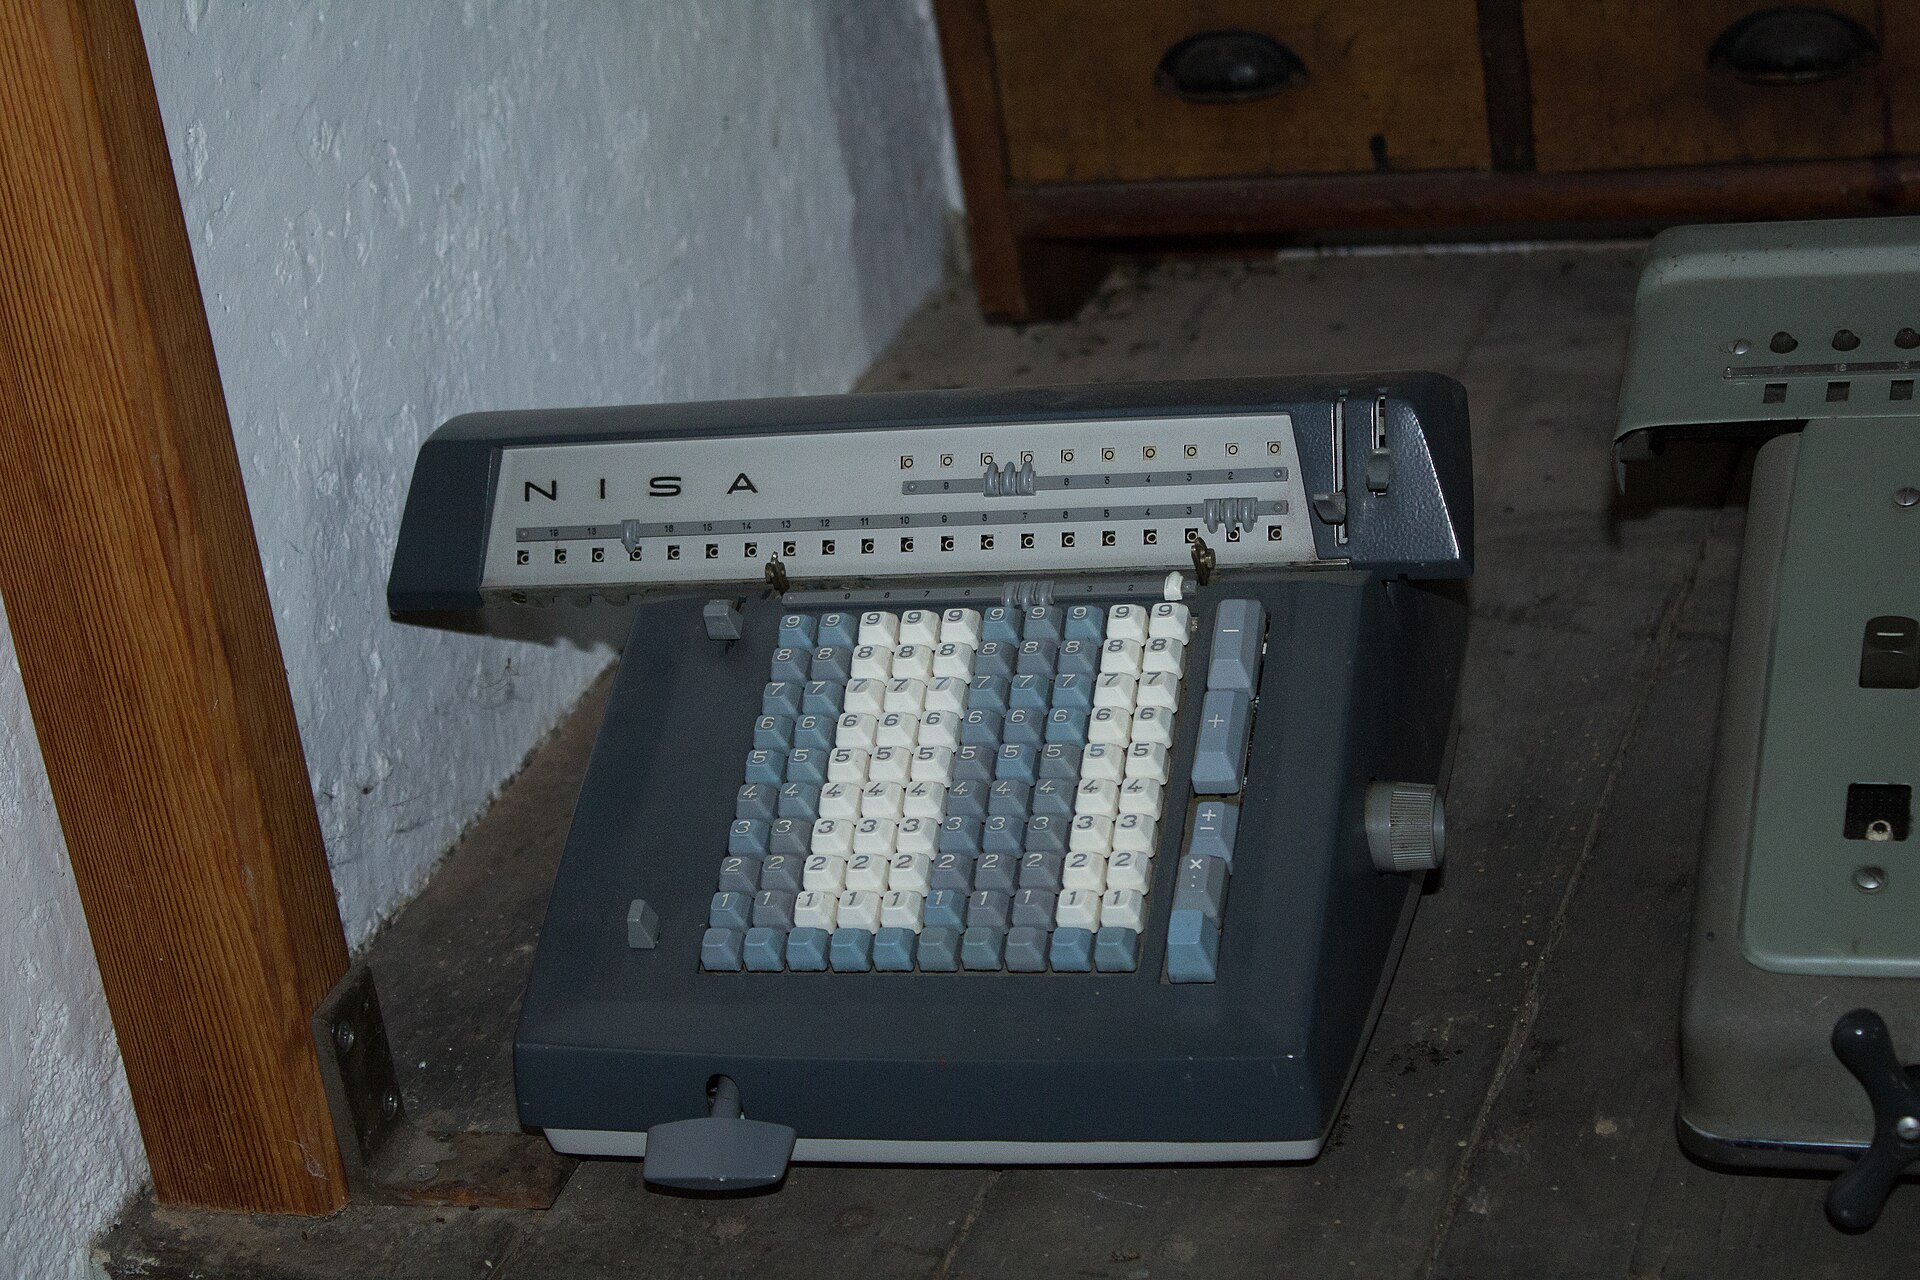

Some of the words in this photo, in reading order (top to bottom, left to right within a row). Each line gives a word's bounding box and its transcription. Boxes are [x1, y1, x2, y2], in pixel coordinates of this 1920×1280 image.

[781, 519, 792, 529] 13
[820, 518, 831, 528] 12
[860, 517, 869, 526] 11
[899, 515, 910, 525] 10
[785, 615, 801, 628] 9
[825, 614, 840, 627] 9
[866, 613, 881, 624] 9
[906, 611, 922, 623] 9
[948, 610, 962, 621] 9
[990, 609, 1005, 620] 9
[1031, 608, 1046, 618] 9
[1072, 608, 1087, 618] 9
[1115, 606, 1130, 618] 9
[1158, 605, 1173, 616] 9
[777, 649, 792, 661] 8
[817, 647, 833, 659] 8
[858, 646, 873, 658] 8
[898, 646, 914, 658] 8
[940, 644, 956, 655] 8
[982, 643, 997, 654] 8
[1024, 642, 1038, 652] 8
[1065, 641, 1080, 652] 8
[1108, 640, 1123, 651] 8
[1151, 639, 1166, 650] 8
[771, 682, 786, 695] 7
[812, 681, 826, 694] 7
[853, 679, 867, 691] 7
[894, 679, 908, 691] 7
[935, 677, 950, 690] 7
[977, 676, 991, 688] 7
[1019, 675, 1033, 687] 7
[1062, 674, 1076, 686] 7
[1104, 673, 1118, 686] 7
[1148, 672, 1161, 684] 7
[761, 717, 774, 729] 6
[802, 716, 816, 728] 6
[843, 714, 858, 726] 6
[884, 714, 899, 726] 6
[926, 712, 941, 724] 6
[968, 711, 982, 723] 6
[1011, 710, 1026, 722] 6
[1054, 710, 1068, 721] 6
[1096, 708, 1111, 720] 6
[1140, 708, 1155, 719] 6
[751, 750, 767, 763] 5
[793, 749, 809, 762] 5
[835, 749, 851, 762] 5
[876, 747, 892, 760] 5
[918, 747, 934, 760] 5
[960, 746, 976, 758] 5
[1004, 745, 1019, 757] 5
[1047, 745, 1062, 757] 5
[1089, 744, 1105, 757] 5
[1133, 744, 1149, 756] 5
[743, 786, 758, 798] 4
[785, 783, 799, 796] 4
[826, 784, 841, 797] 4
[868, 783, 883, 796] 4
[911, 783, 925, 795] 4
[954, 782, 968, 794] 4
[996, 782, 1010, 794] 4
[1040, 780, 1054, 793] 4
[1083, 780, 1098, 793] 4
[1127, 780, 1142, 792] 4
[735, 821, 750, 834] 3
[776, 820, 792, 832] 3
[818, 821, 835, 833] 3
[860, 819, 876, 832] 3
[903, 818, 920, 831] 3
[946, 817, 962, 830] 3
[990, 817, 1006, 830] 3
[1033, 817, 1049, 829] 3
[1077, 816, 1093, 829] 3
[1121, 815, 1137, 828] 3
[725, 859, 742, 872] 2
[768, 856, 784, 869] 2
[809, 857, 826, 870] 2
[852, 856, 869, 869] 2
[895, 855, 912, 868] 2
[938, 855, 955, 868] 2
[982, 854, 999, 867] 2
[1026, 854, 1043, 867] 2
[1071, 854, 1088, 867] 2
[1115, 853, 1132, 866] 2
[720, 893, 730, 907] 1
[763, 892, 771, 905] 1
[806, 893, 815, 906] 1
[849, 892, 858, 905] 1
[892, 892, 901, 905] 1
[935, 891, 943, 905] 1
[980, 891, 988, 905] 1
[1024, 890, 1032, 903] 1
[1069, 892, 1077, 905] 1
[1114, 891, 1121, 905] 1
